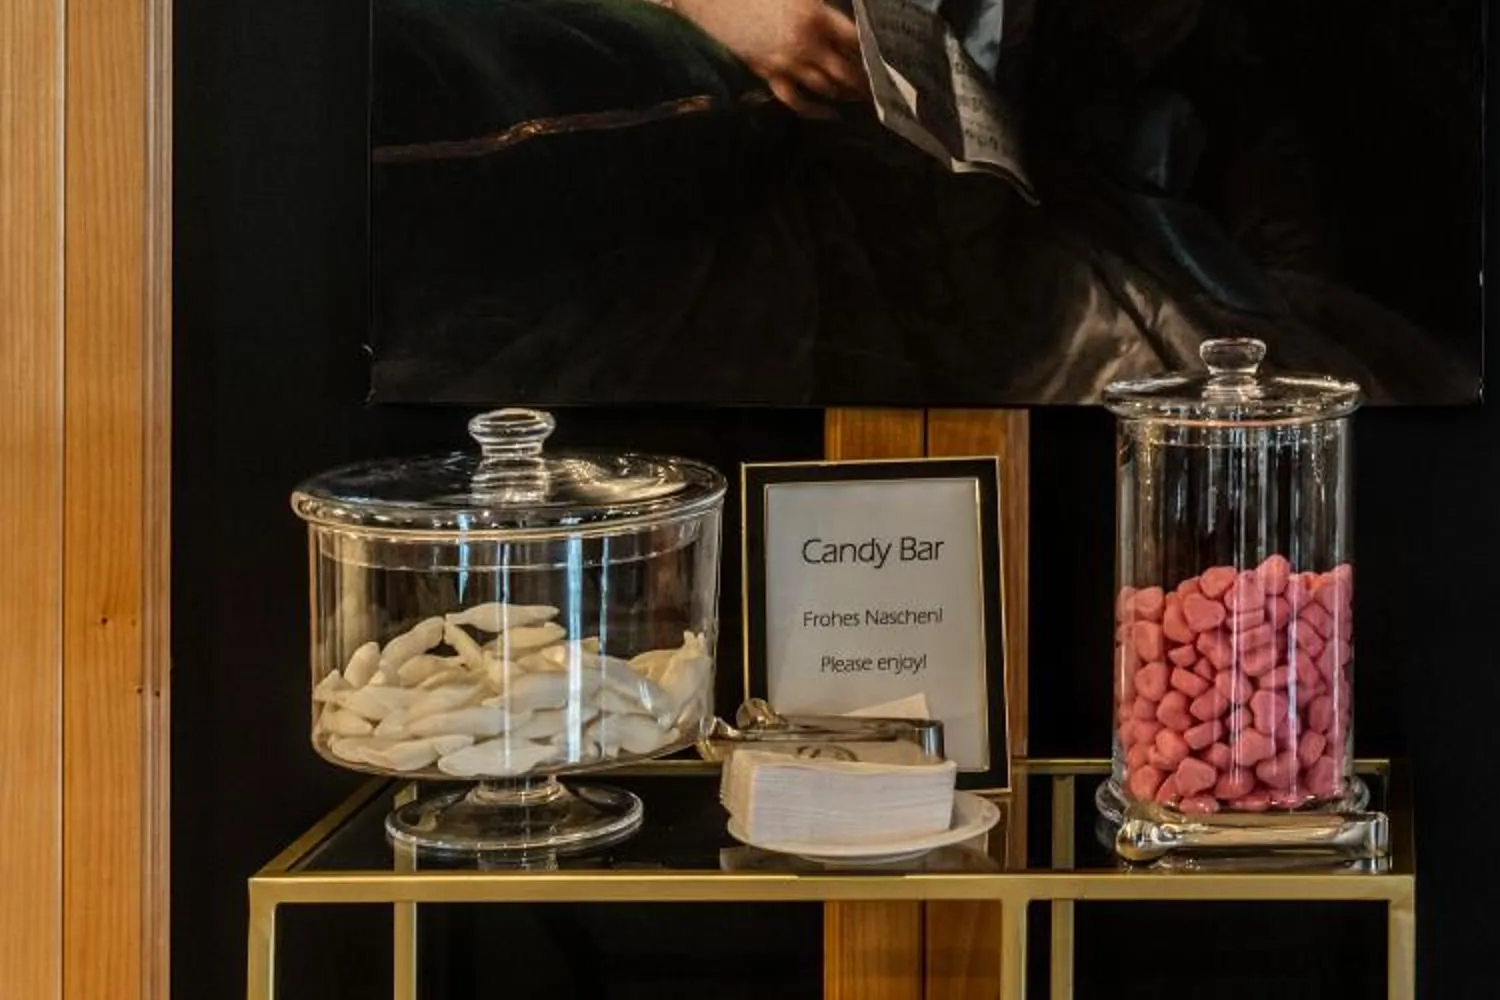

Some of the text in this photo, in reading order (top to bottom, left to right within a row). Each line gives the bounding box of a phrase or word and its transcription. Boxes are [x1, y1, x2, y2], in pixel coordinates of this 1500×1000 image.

[801, 535, 945, 569] Candy Bar
[803, 607, 943, 628] Frohes Naschen!
[820, 653, 927, 675] Please enjoy!
